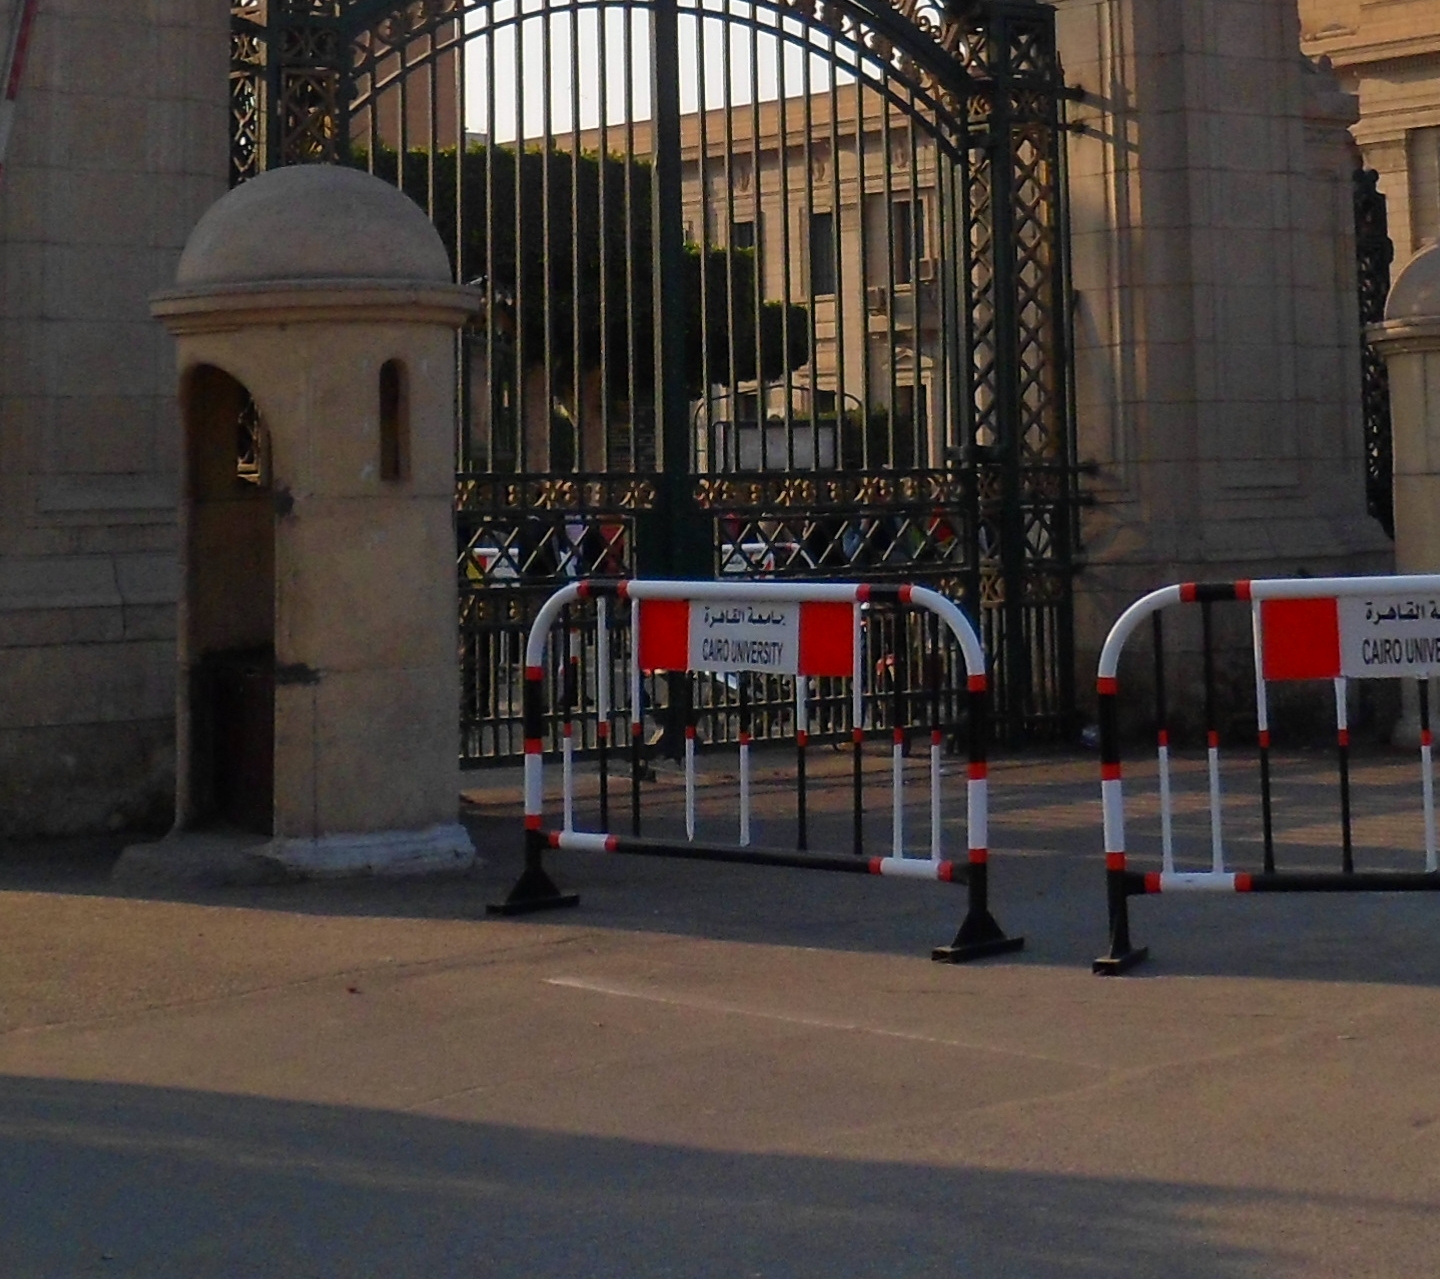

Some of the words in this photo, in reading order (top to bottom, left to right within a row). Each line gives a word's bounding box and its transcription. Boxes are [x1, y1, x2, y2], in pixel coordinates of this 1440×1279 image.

[704, 606, 745, 628] القاهرة
[748, 606, 786, 626] جامعة
[1365, 601, 1425, 625] القاهرة
[702, 638, 729, 662] CAIRO
[730, 639, 784, 666] UNIVERSITY
[1362, 638, 1402, 665] CAIRO
